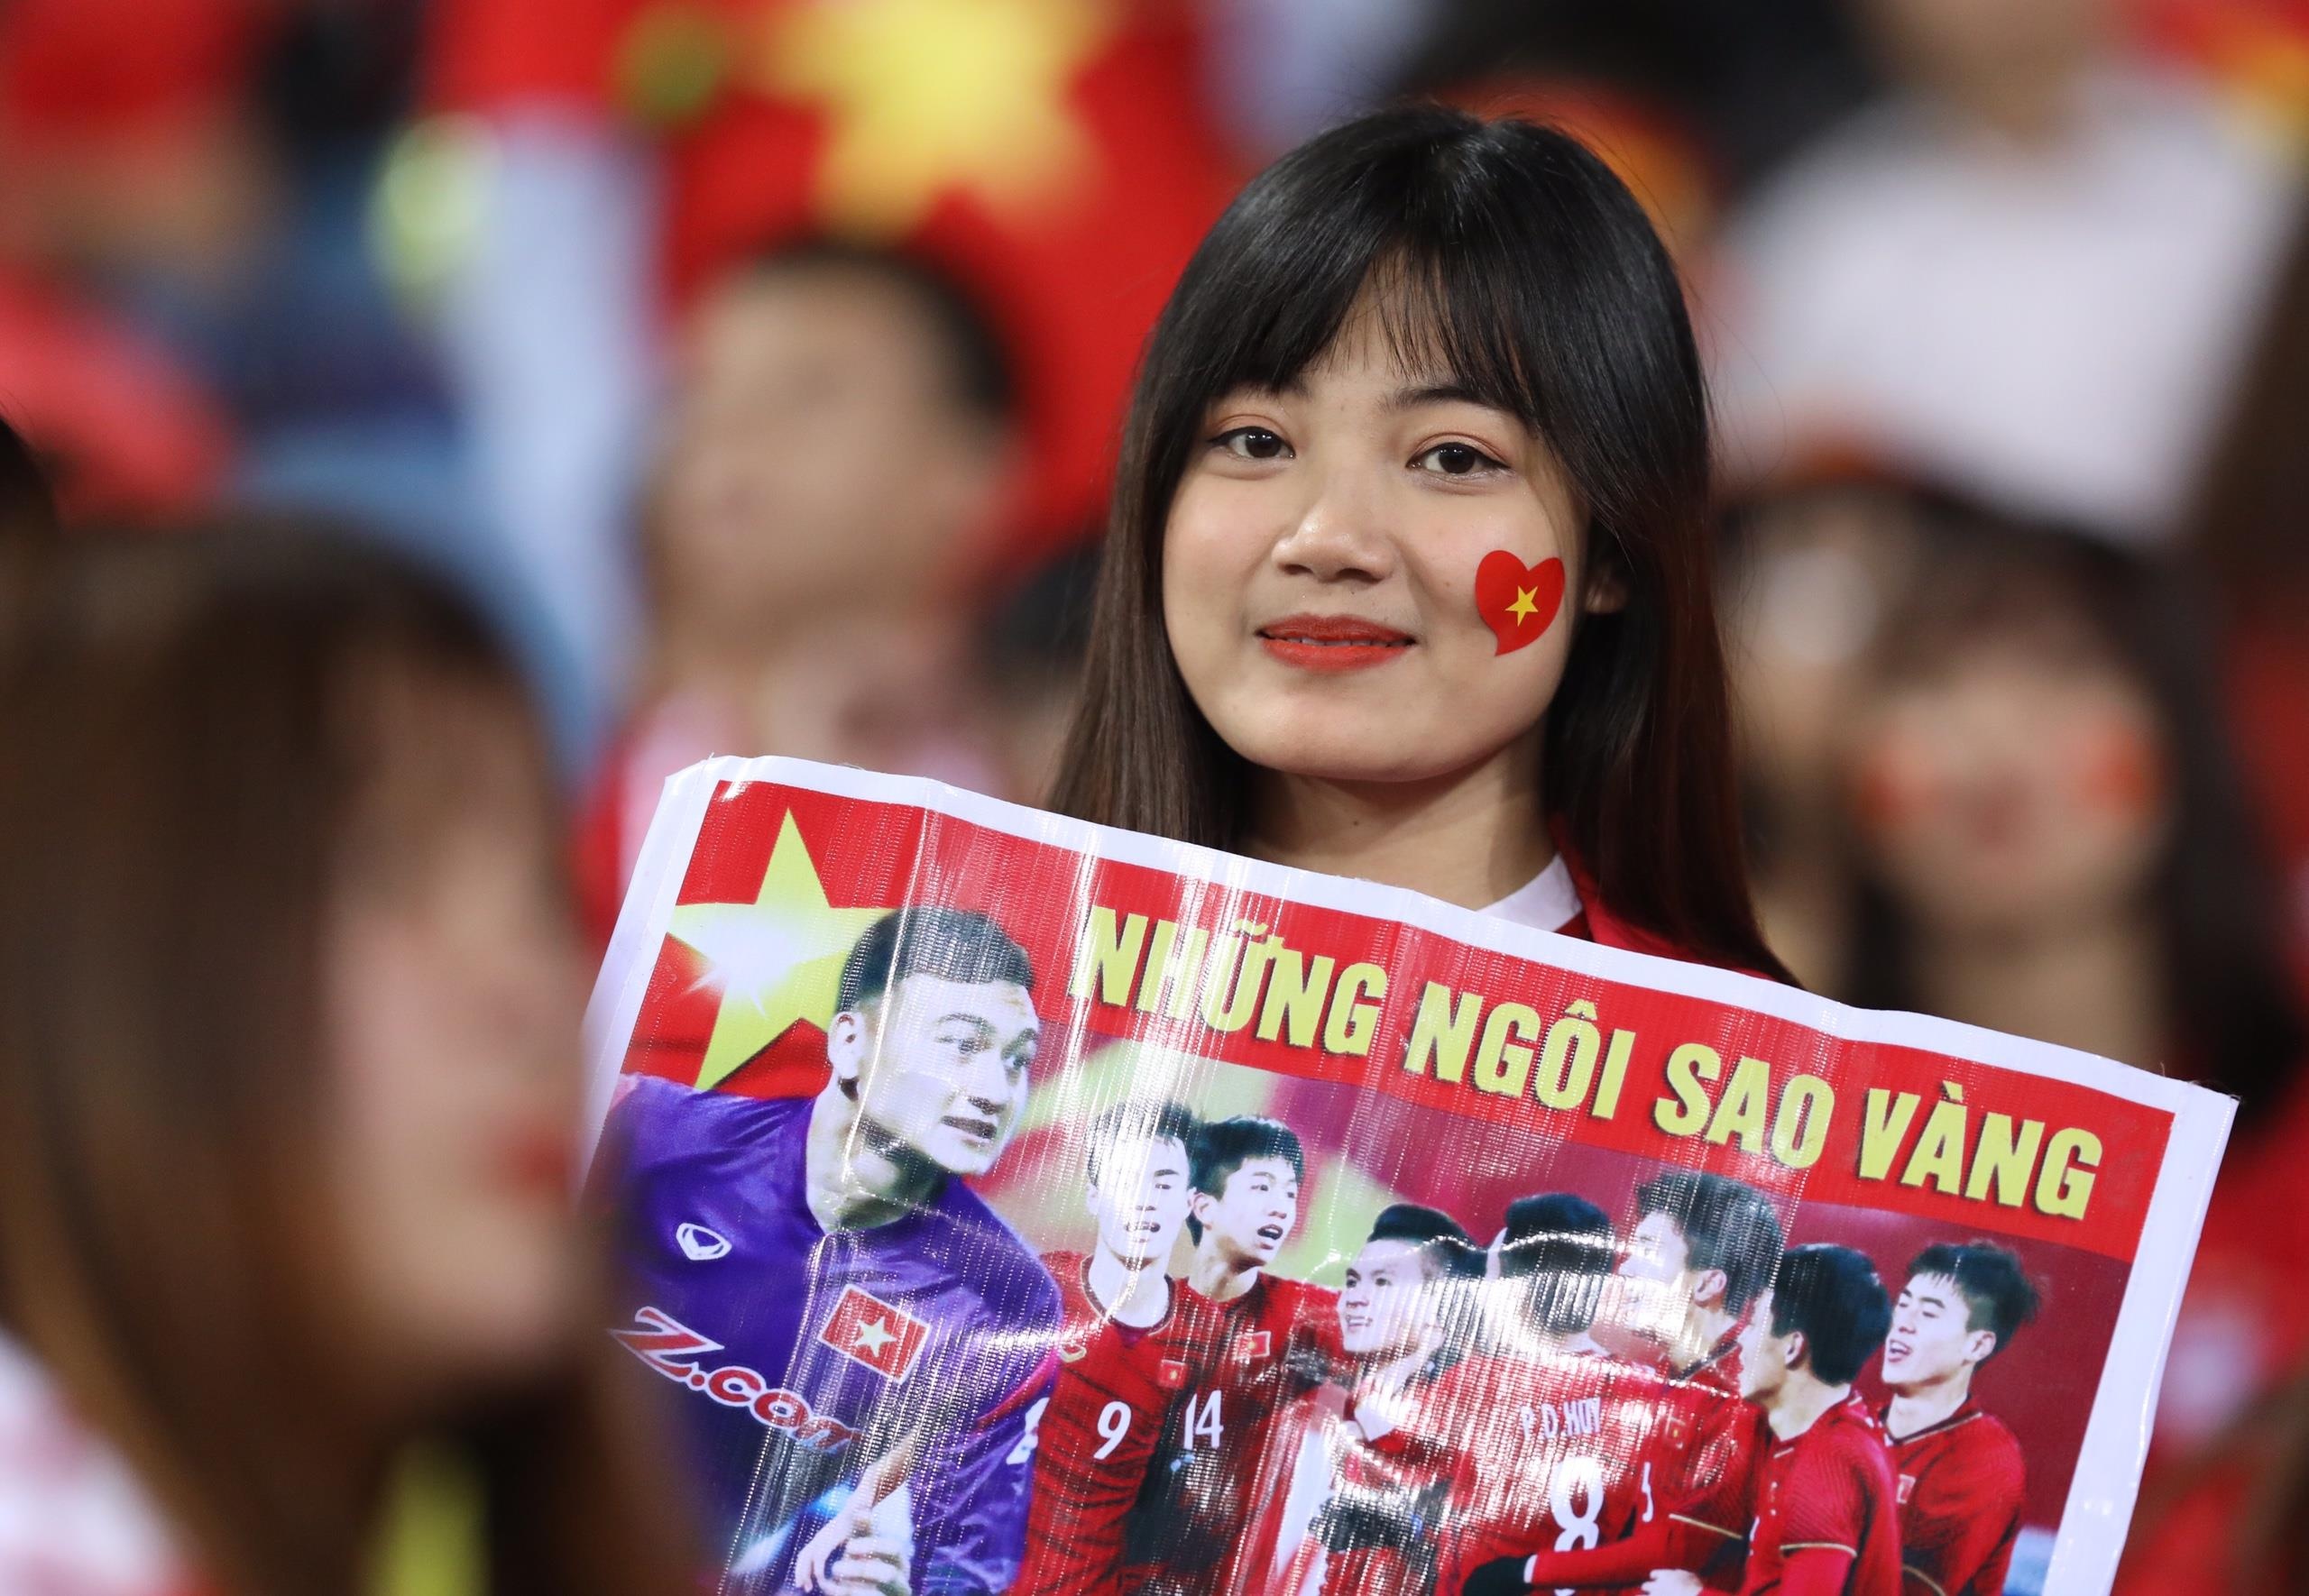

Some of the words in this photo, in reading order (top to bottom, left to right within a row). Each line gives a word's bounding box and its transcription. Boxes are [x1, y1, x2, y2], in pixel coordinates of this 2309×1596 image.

[1067, 904, 1389, 1057] NHỮNG
[1403, 979, 1636, 1121] NGÔI
[1653, 1042, 1835, 1169] SAO
[1858, 1080, 2104, 1221] VÀNG
[1093, 1400, 1132, 1460] 9
[1183, 1390, 1224, 1450] 14
[1550, 1455, 1605, 1553] 8
